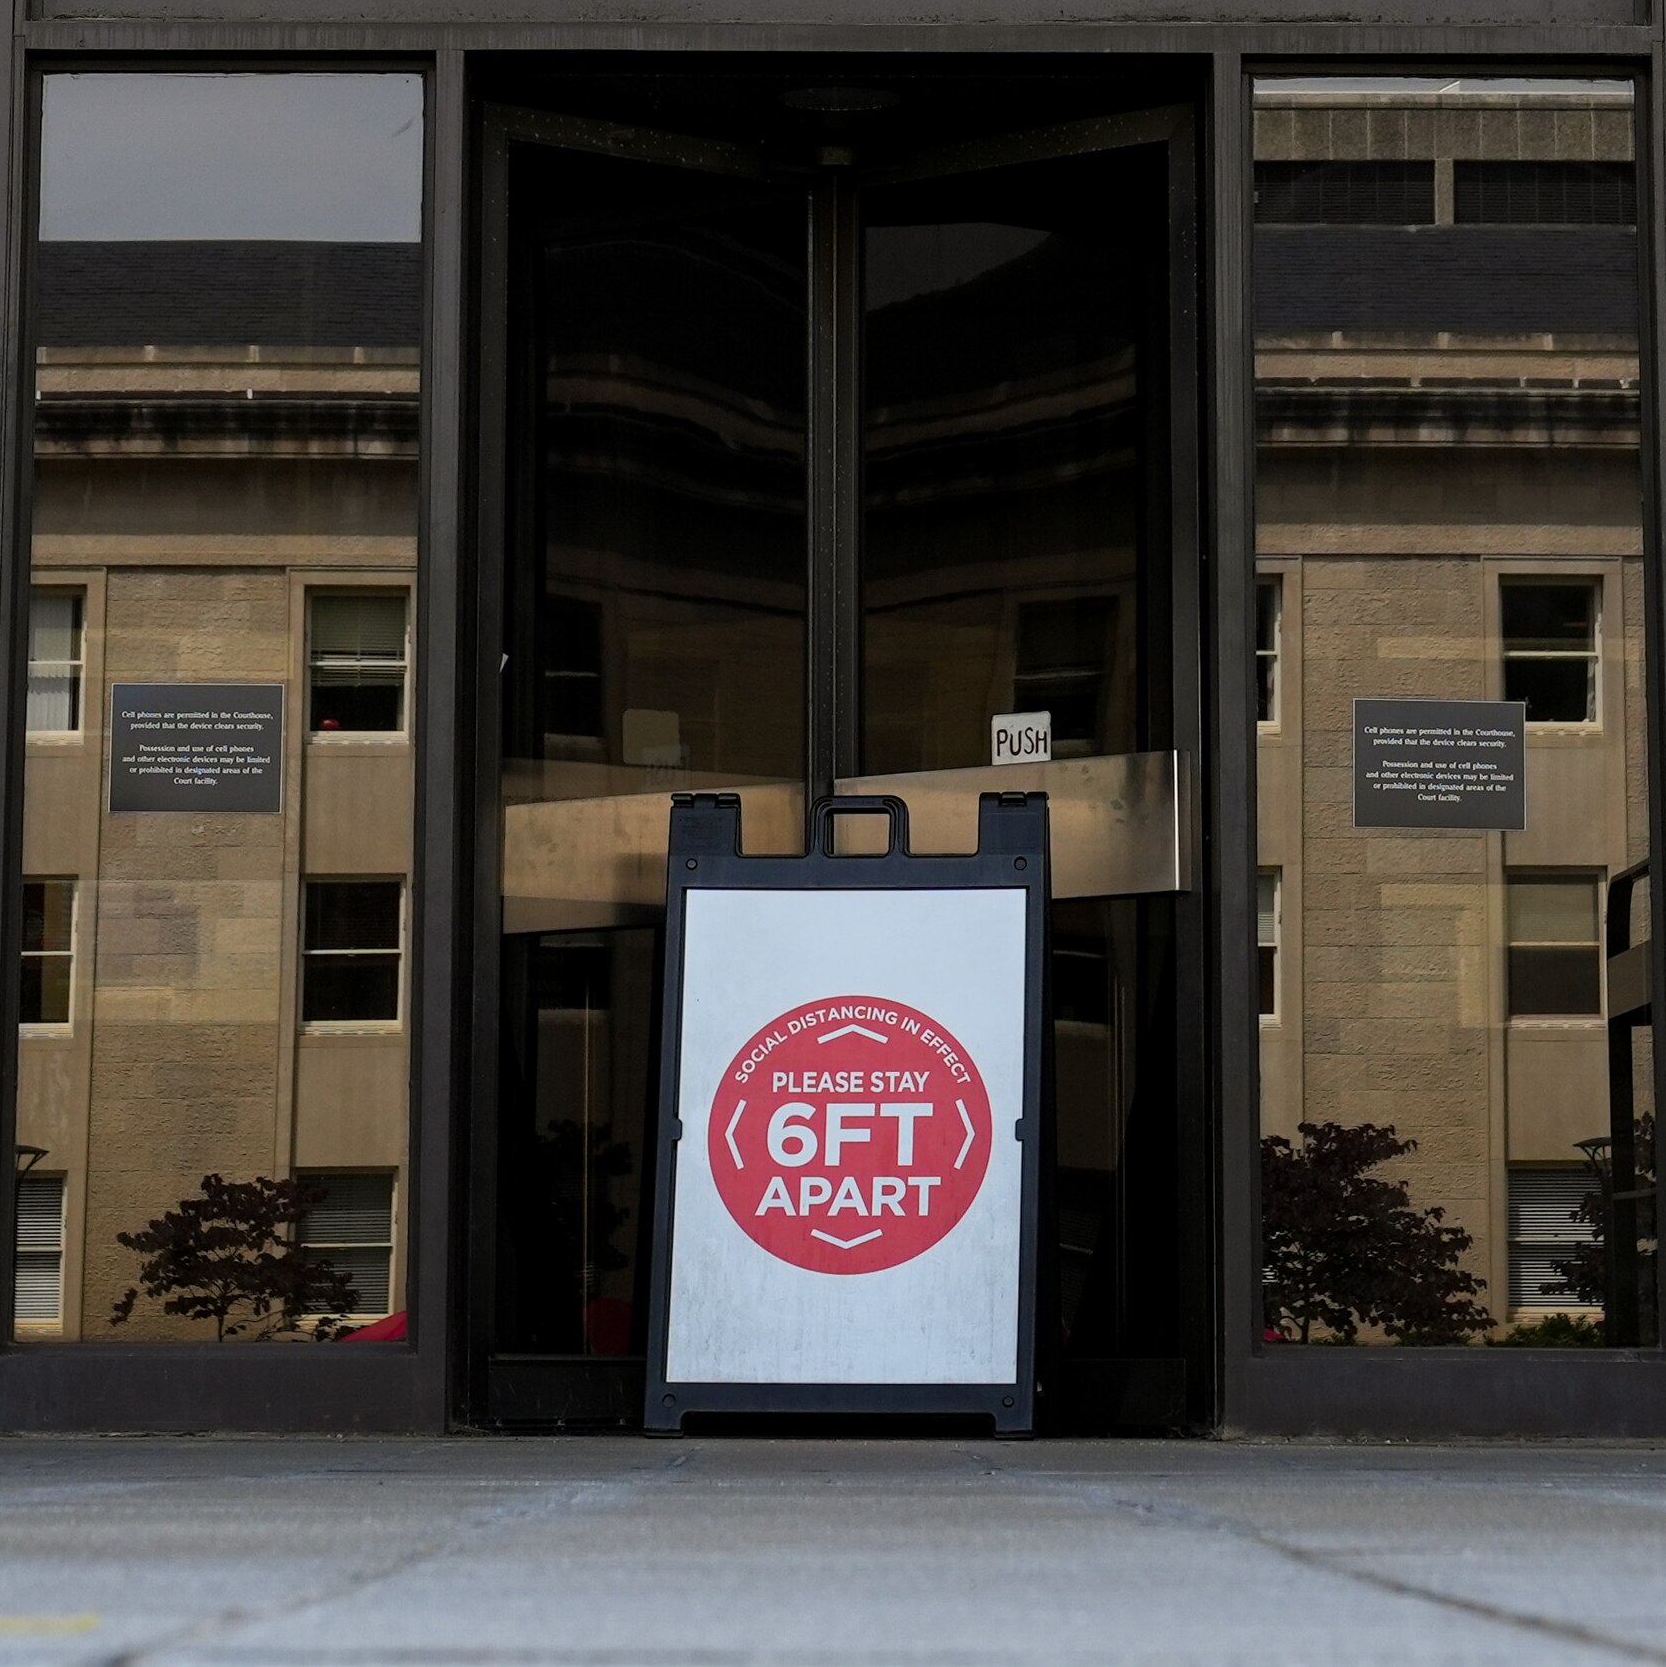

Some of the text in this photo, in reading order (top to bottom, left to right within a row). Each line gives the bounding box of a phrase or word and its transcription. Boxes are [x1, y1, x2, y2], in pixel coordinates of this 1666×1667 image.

[137, 711, 162, 719] phones
[177, 711, 210, 719] permitted
[130, 722, 160, 730] provided
[1364, 726, 1378, 734] Cell
[1380, 727, 1404, 735] phones
[1419, 728, 1452, 736] permitted
[996, 727, 1047, 757] PUSH
[1373, 737, 1403, 746] provided
[1420, 738, 1431, 746] the
[1433, 738, 1455, 746] device
[1457, 739, 1477, 747] clears
[229, 745, 254, 753] phones
[157, 755, 191, 763] electronic
[139, 766, 173, 774] prohibited
[184, 766, 221, 774] designated
[1382, 760, 1418, 768] Possession
[1473, 762, 1497, 770] phones
[1381, 771, 1399, 779] other
[1436, 772, 1461, 780] devices
[1490, 773, 1514, 781] limited
[1383, 782, 1417, 790] prohibited
[1428, 783, 1464, 791] designated
[1418, 793, 1436, 801] Court
[735, 1005, 971, 1085] SOCIAL DISTANCING IN EFFECT
[772, 1071, 930, 1093] PLEASE STAY
[766, 1102, 934, 1167] 6FT
[754, 1176, 942, 1217] APART
